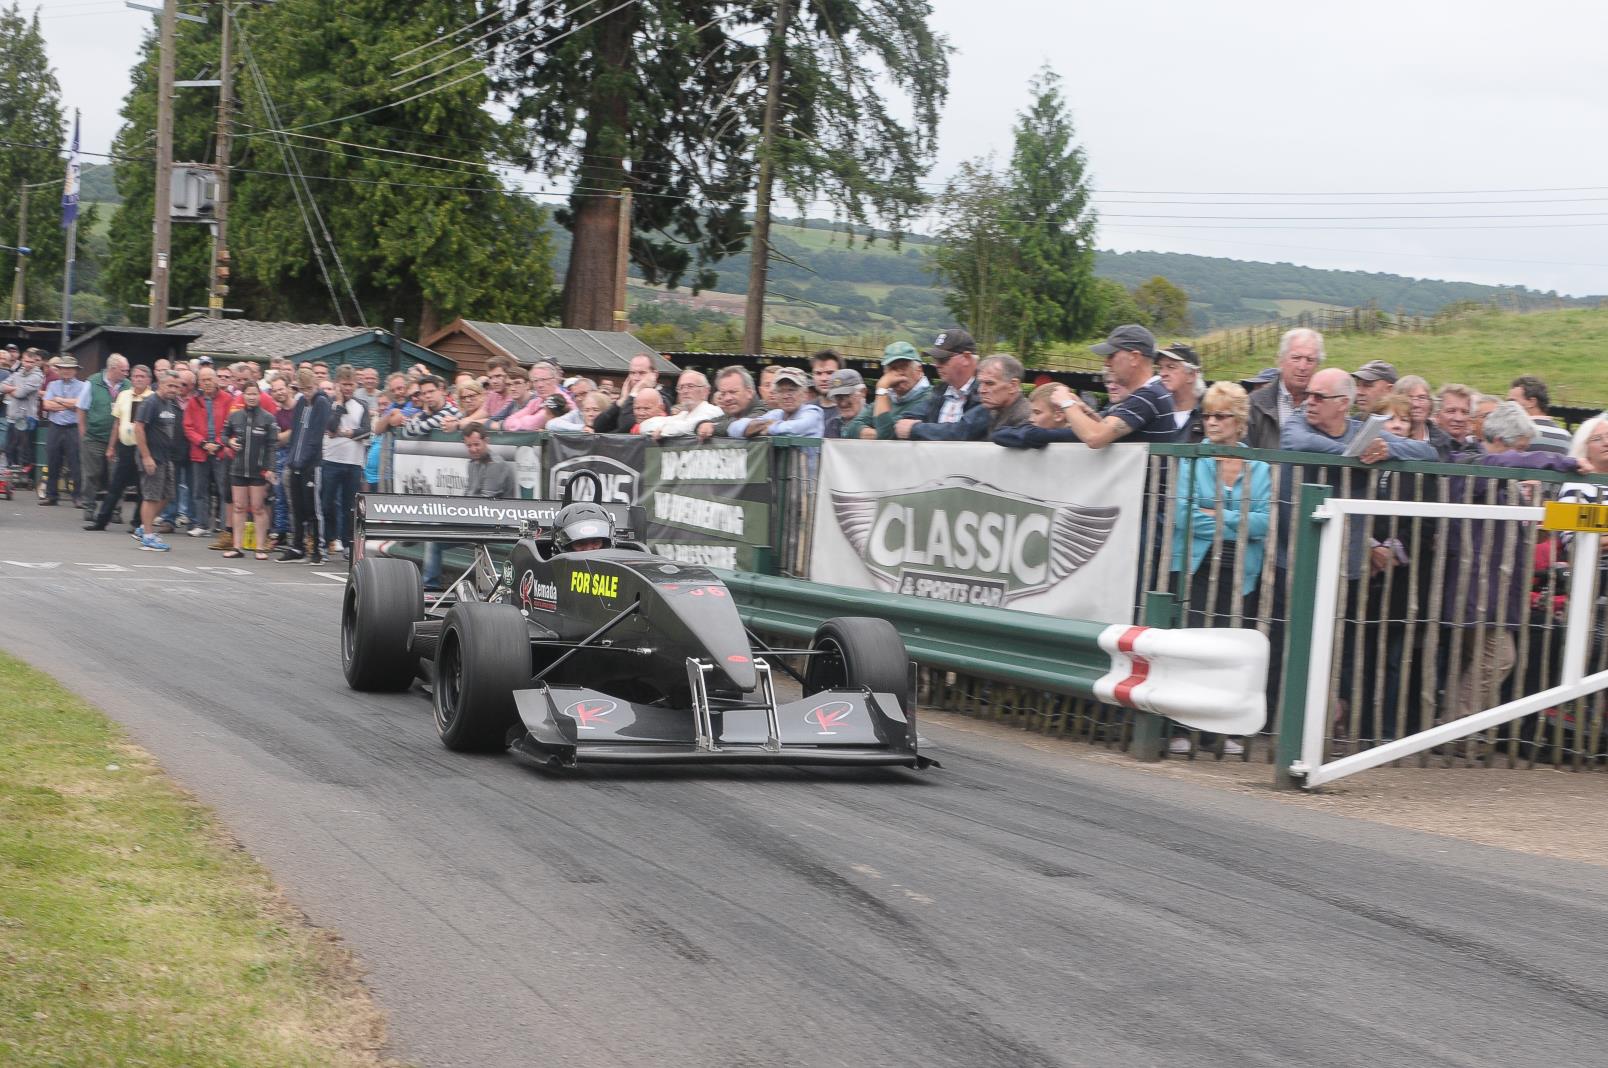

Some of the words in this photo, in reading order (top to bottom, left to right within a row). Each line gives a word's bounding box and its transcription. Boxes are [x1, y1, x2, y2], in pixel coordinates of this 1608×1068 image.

[373, 502, 616, 523] www.tillicoultryquarri
[869, 502, 1050, 585] CLASSIC
[533, 579, 558, 600] Kemada
[571, 571, 590, 594] FOR
[592, 573, 619, 599] SALE
[901, 576, 915, 595] &
[916, 578, 970, 603] SPORTS
[969, 585, 1003, 609] CAR
